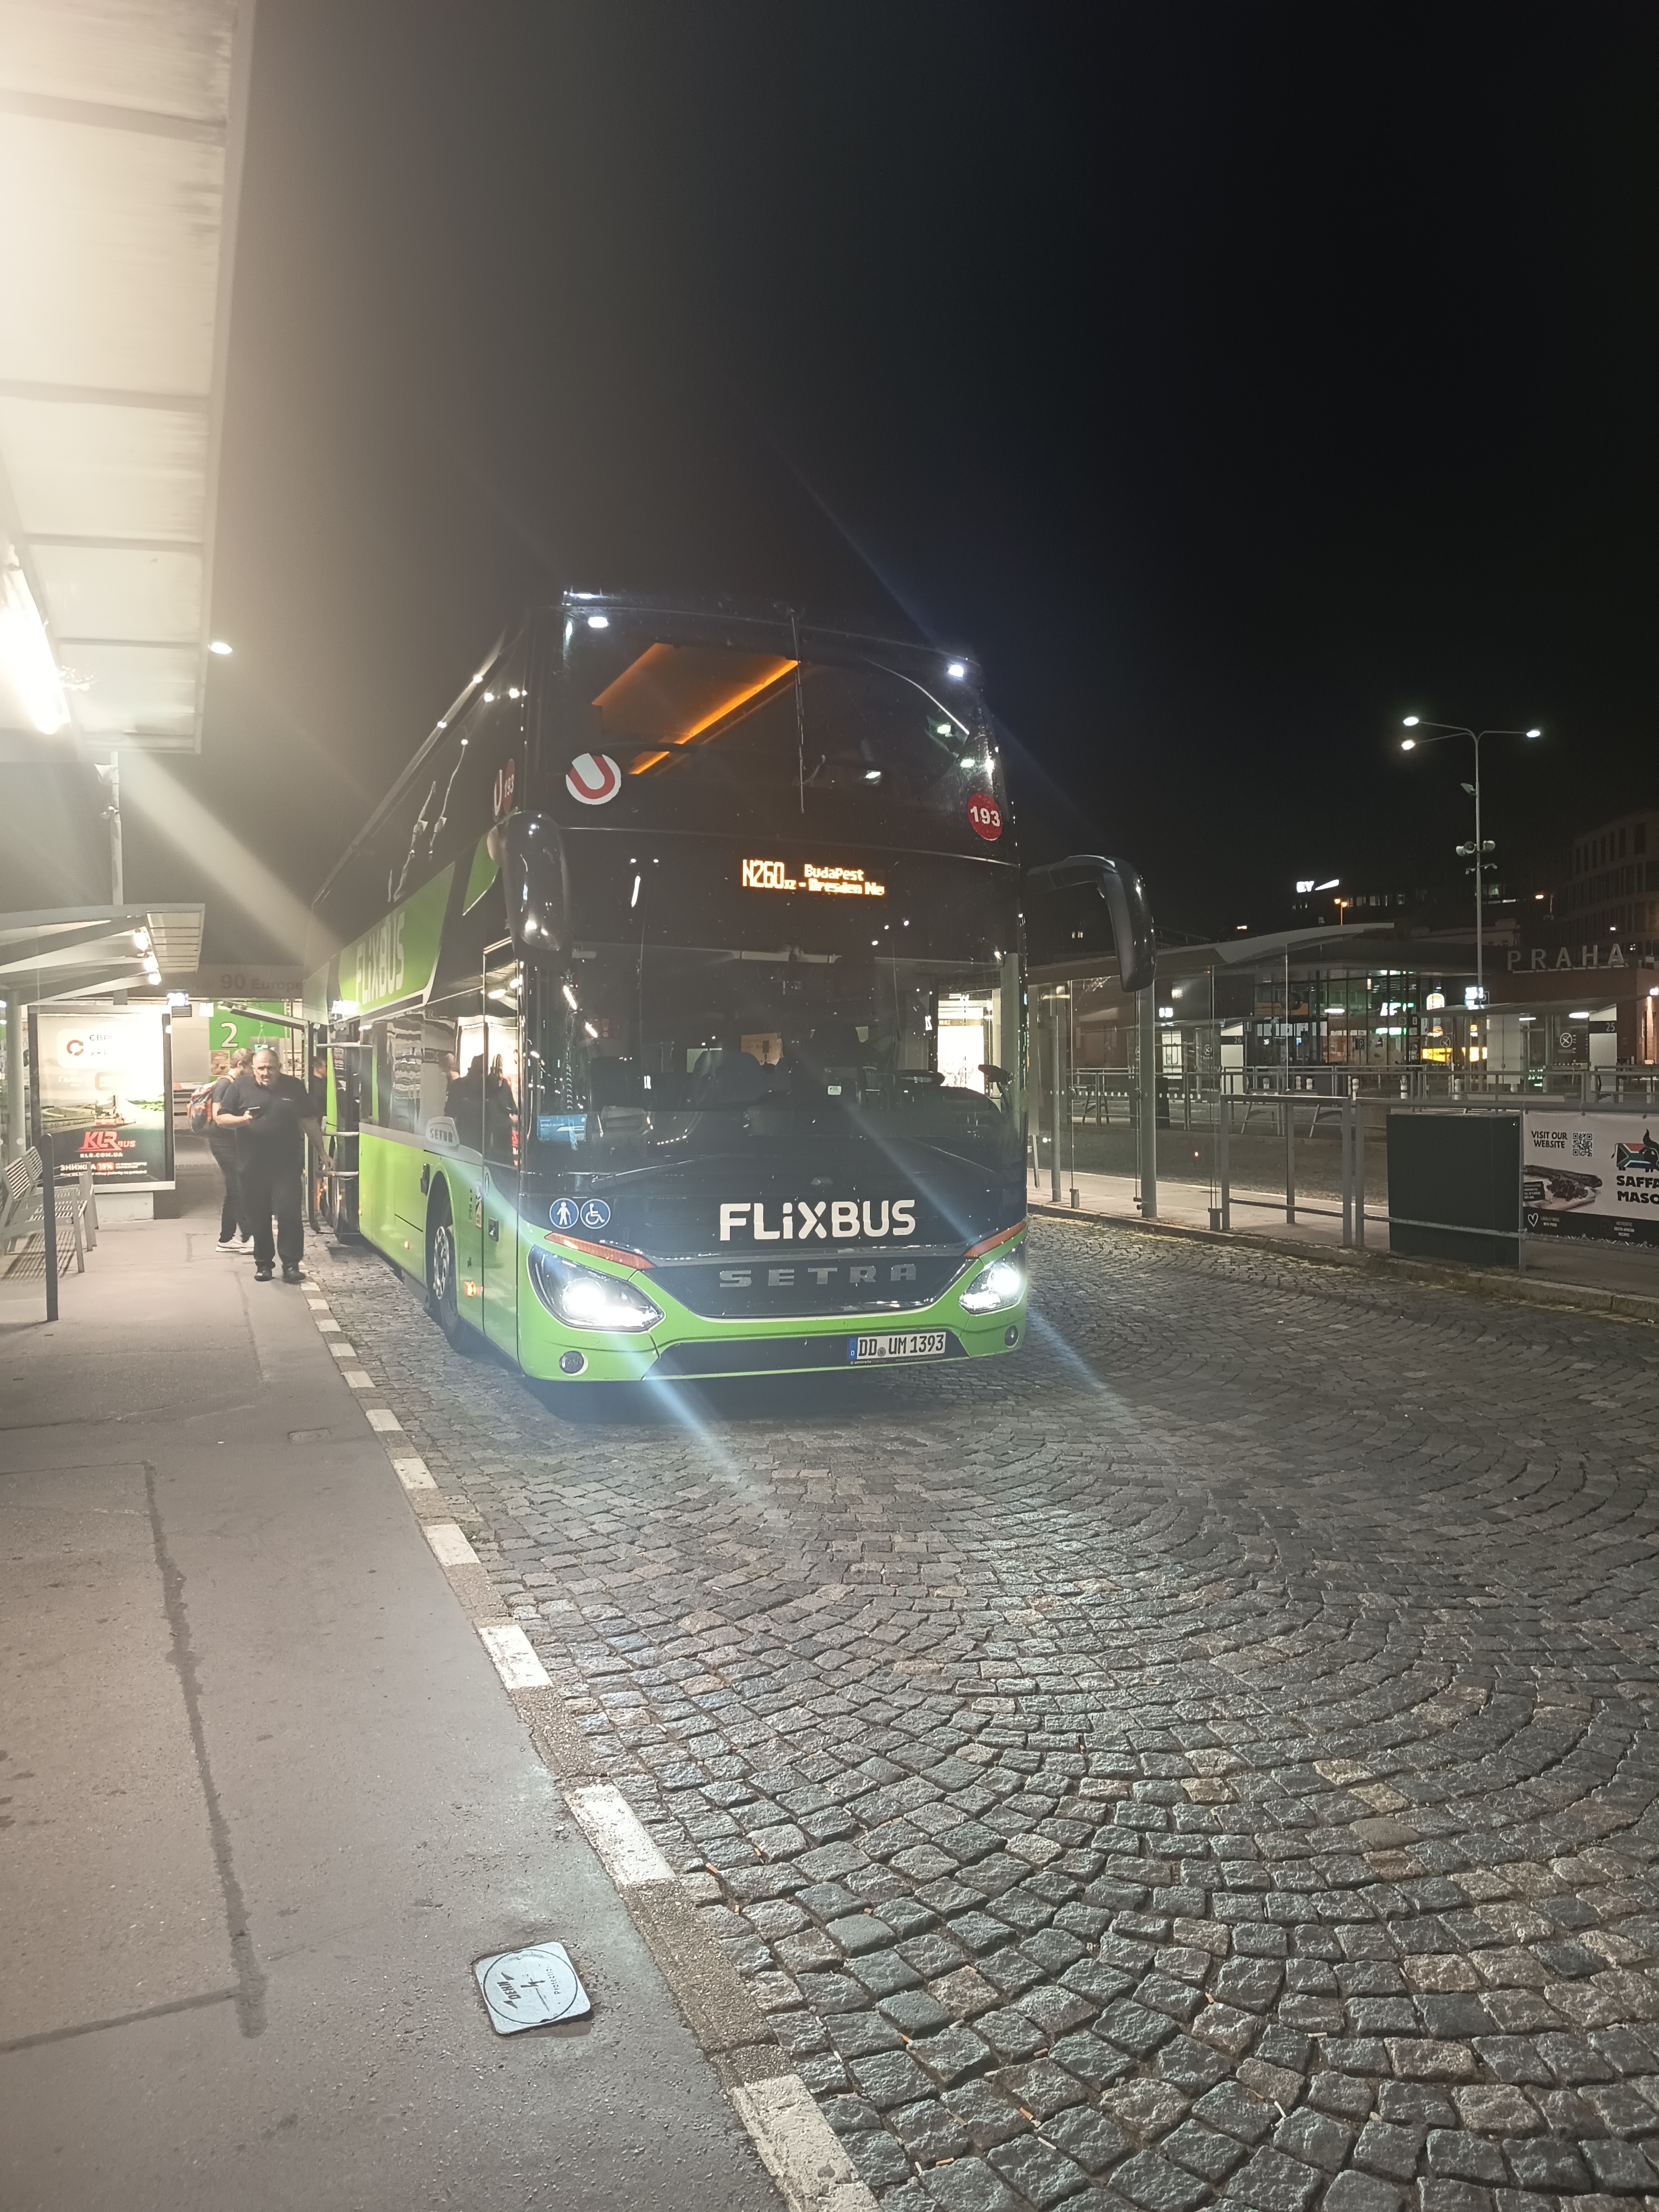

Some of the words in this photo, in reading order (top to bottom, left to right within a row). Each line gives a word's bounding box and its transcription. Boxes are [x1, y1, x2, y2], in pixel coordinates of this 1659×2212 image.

[970, 806, 1000, 827] 193
[743, 859, 784, 889] N260
[808, 878, 862, 894] Dresden
[1296, 881, 1314, 893] EY
[1507, 943, 1625, 971] PRAHA
[221, 974, 246, 989] 90
[221, 1022, 239, 1048] 2
[1606, 1022, 1615, 1032] 25
[83, 1131, 121, 1150] KLR
[1531, 1131, 1550, 1139] VISIT
[1534, 1140, 1566, 1149] WEBSITE
[1616, 1176, 1659, 1188] SAFFA
[719, 1264, 916, 1287] SETRA
[858, 1339, 878, 1357] DD
[888, 1337, 907, 1354] UM
[910, 1334, 944, 1353] 1393
[497, 1981, 521, 2000] DEHN
